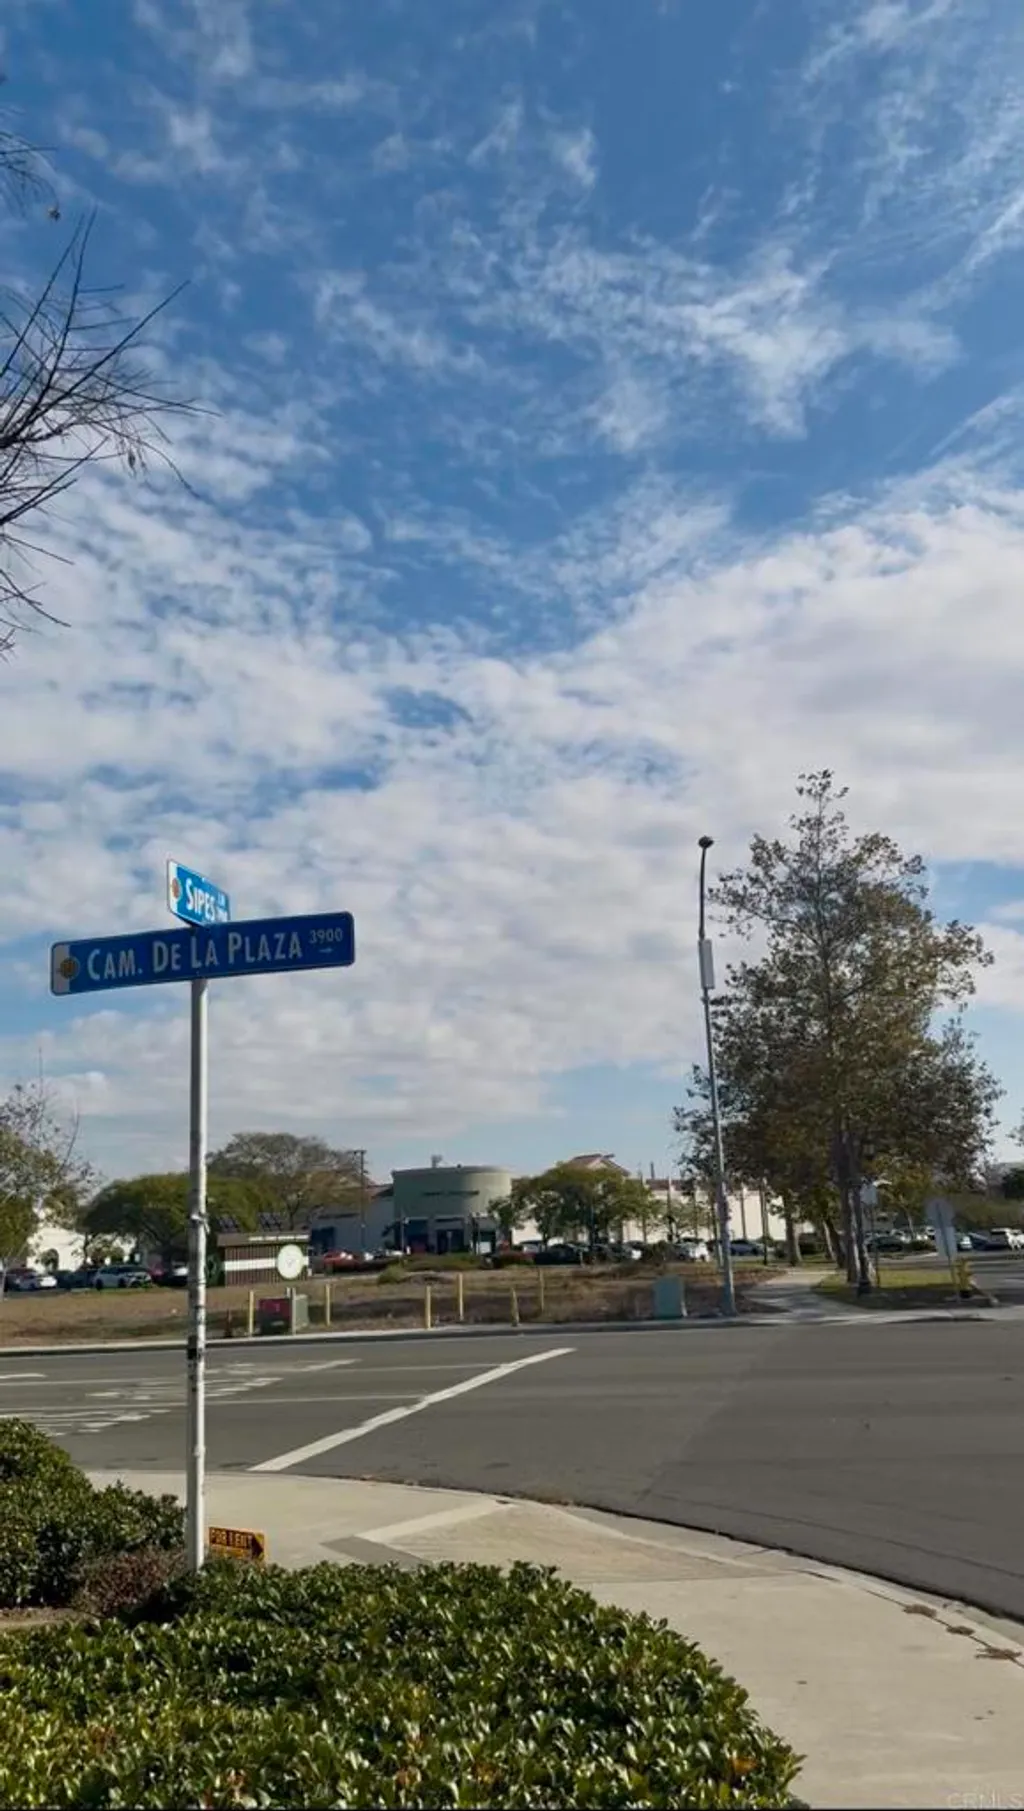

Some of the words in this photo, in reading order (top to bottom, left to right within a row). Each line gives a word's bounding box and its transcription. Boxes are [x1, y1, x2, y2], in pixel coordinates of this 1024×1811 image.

[87, 948, 143, 981] CAM.
[153, 940, 182, 972] DE
[191, 935, 219, 968] LA
[228, 931, 303, 965] PLAZA
[308, 926, 344, 944] 3900
